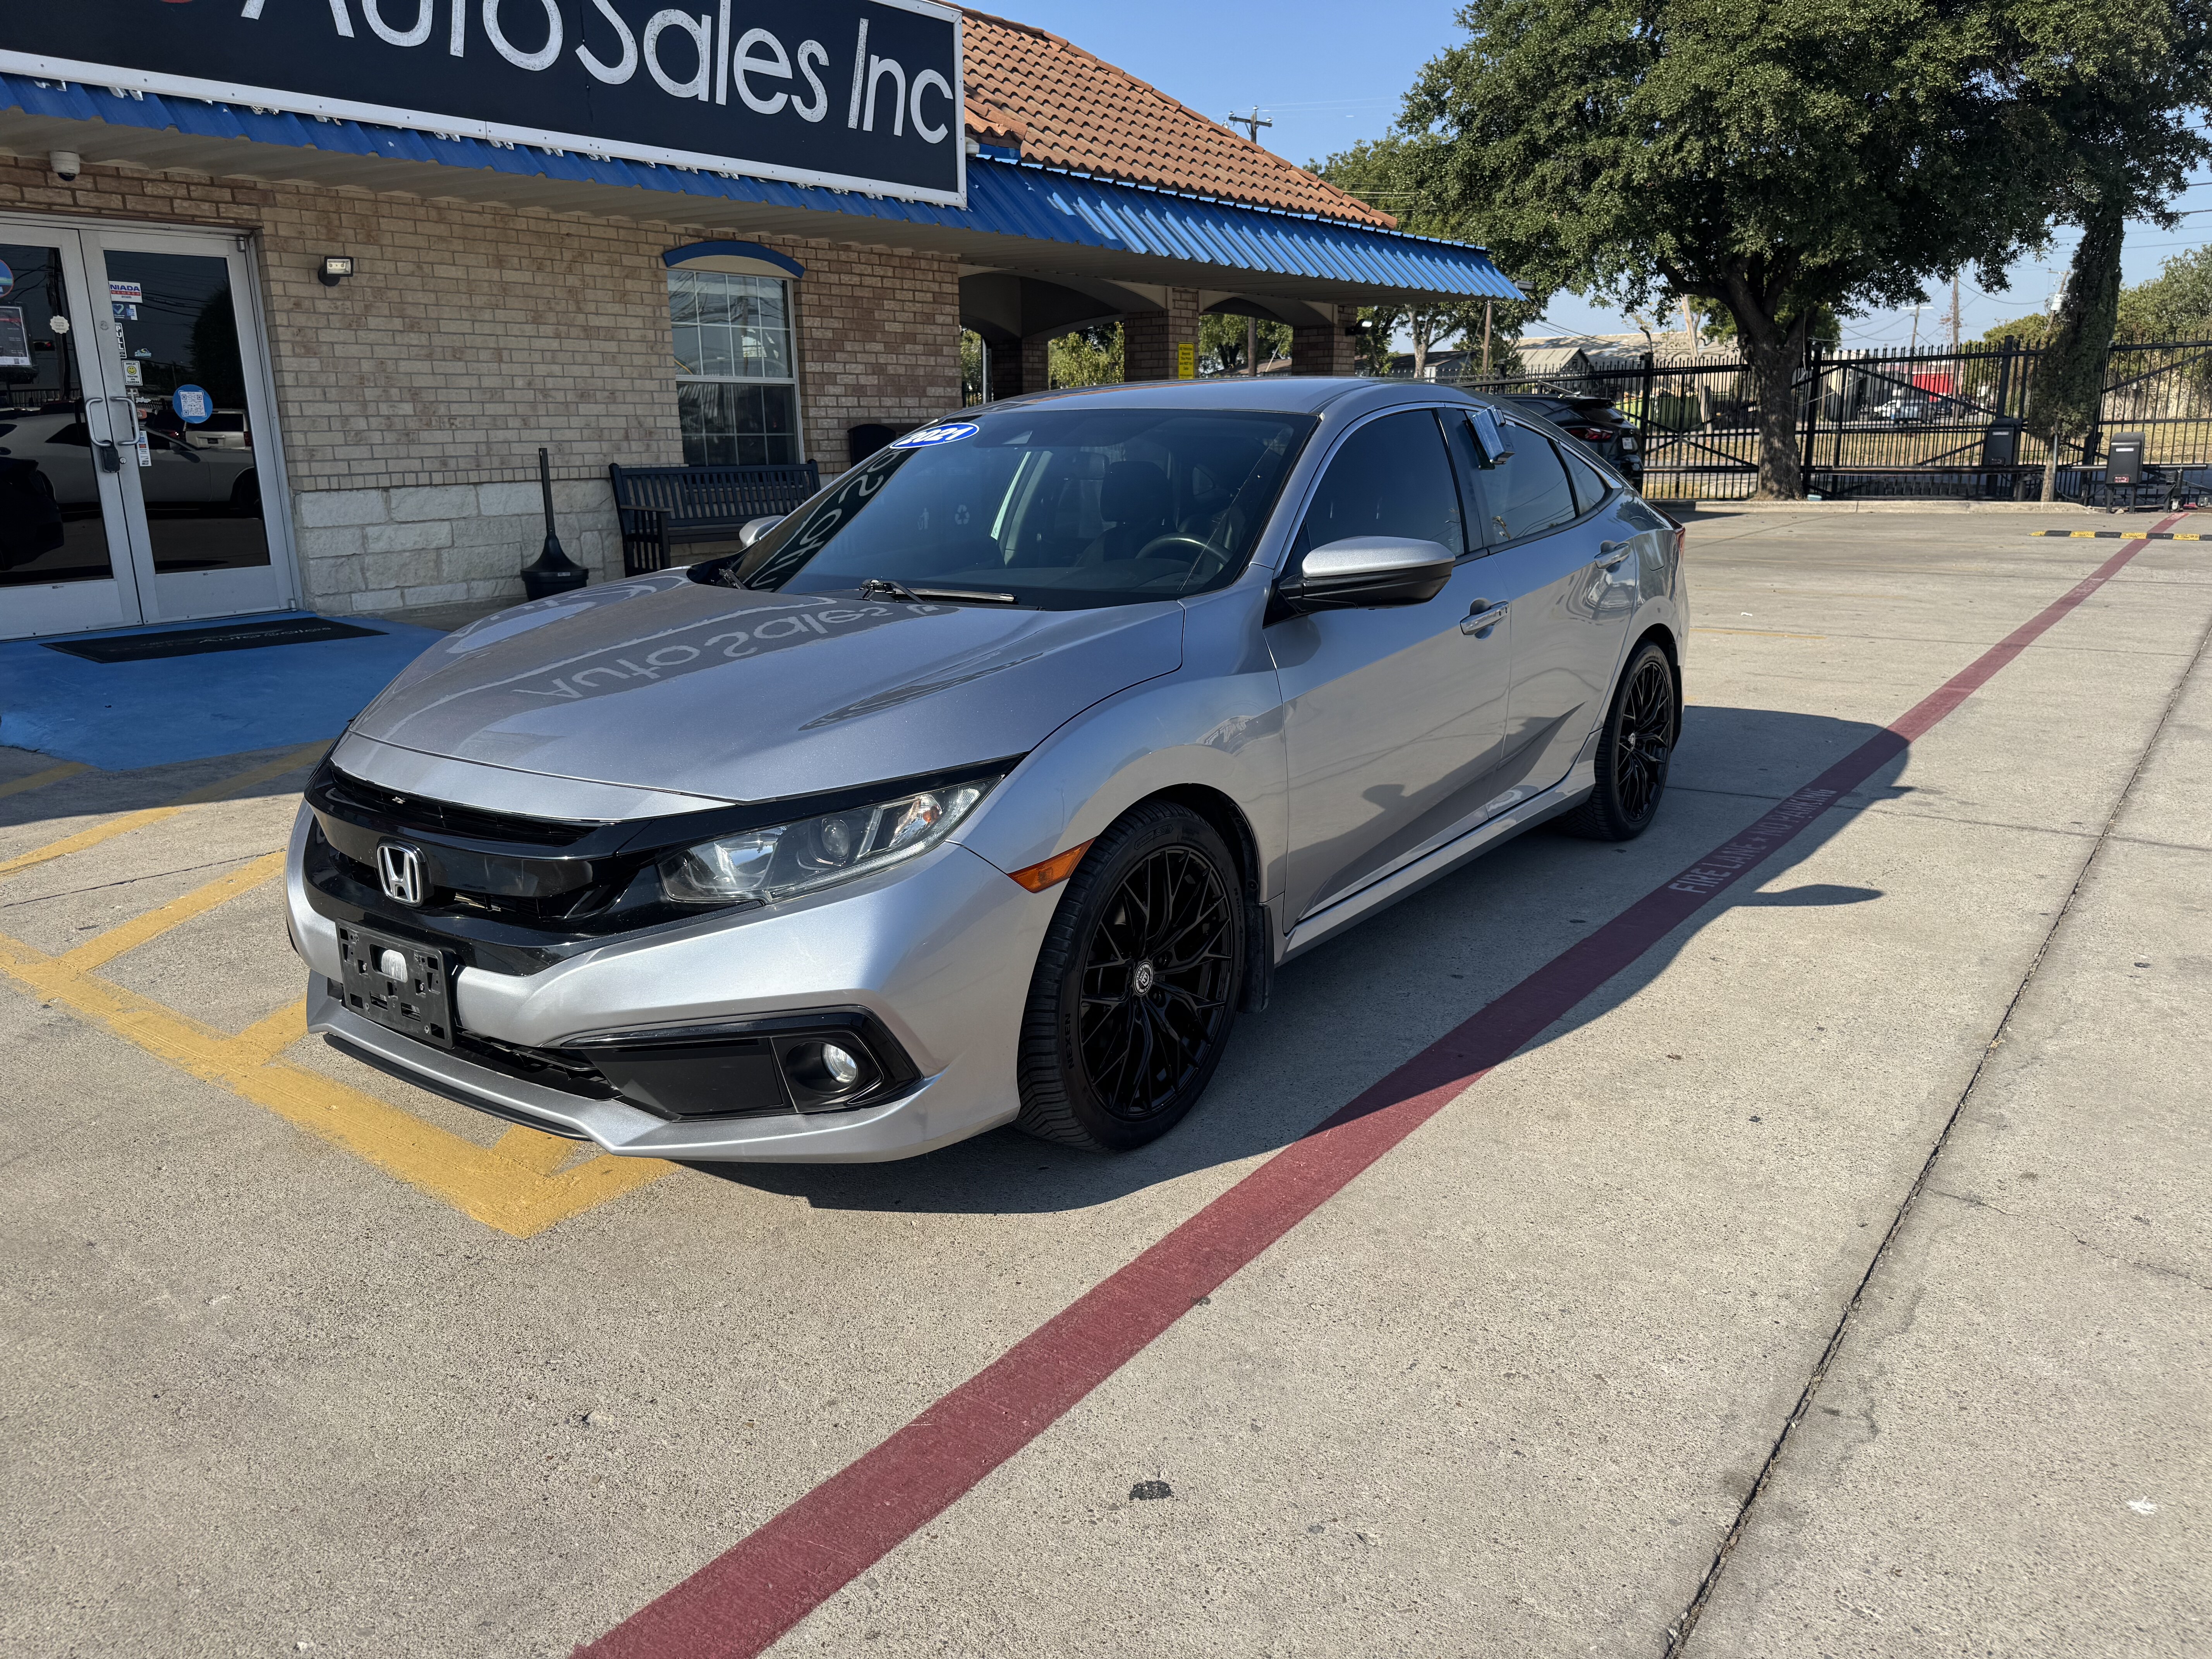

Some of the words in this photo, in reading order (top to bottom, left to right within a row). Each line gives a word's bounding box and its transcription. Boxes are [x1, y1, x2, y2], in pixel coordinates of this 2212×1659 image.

[848, 18, 954, 143] Inc
[116, 326, 124, 350] PULL
[895, 427, 974, 447] 2021
[1748, 822, 1794, 836] NO
[1698, 842, 1767, 869] LANE
[1668, 868, 1733, 894] FIRE
[1065, 1013, 1075, 1070] NEXEN
